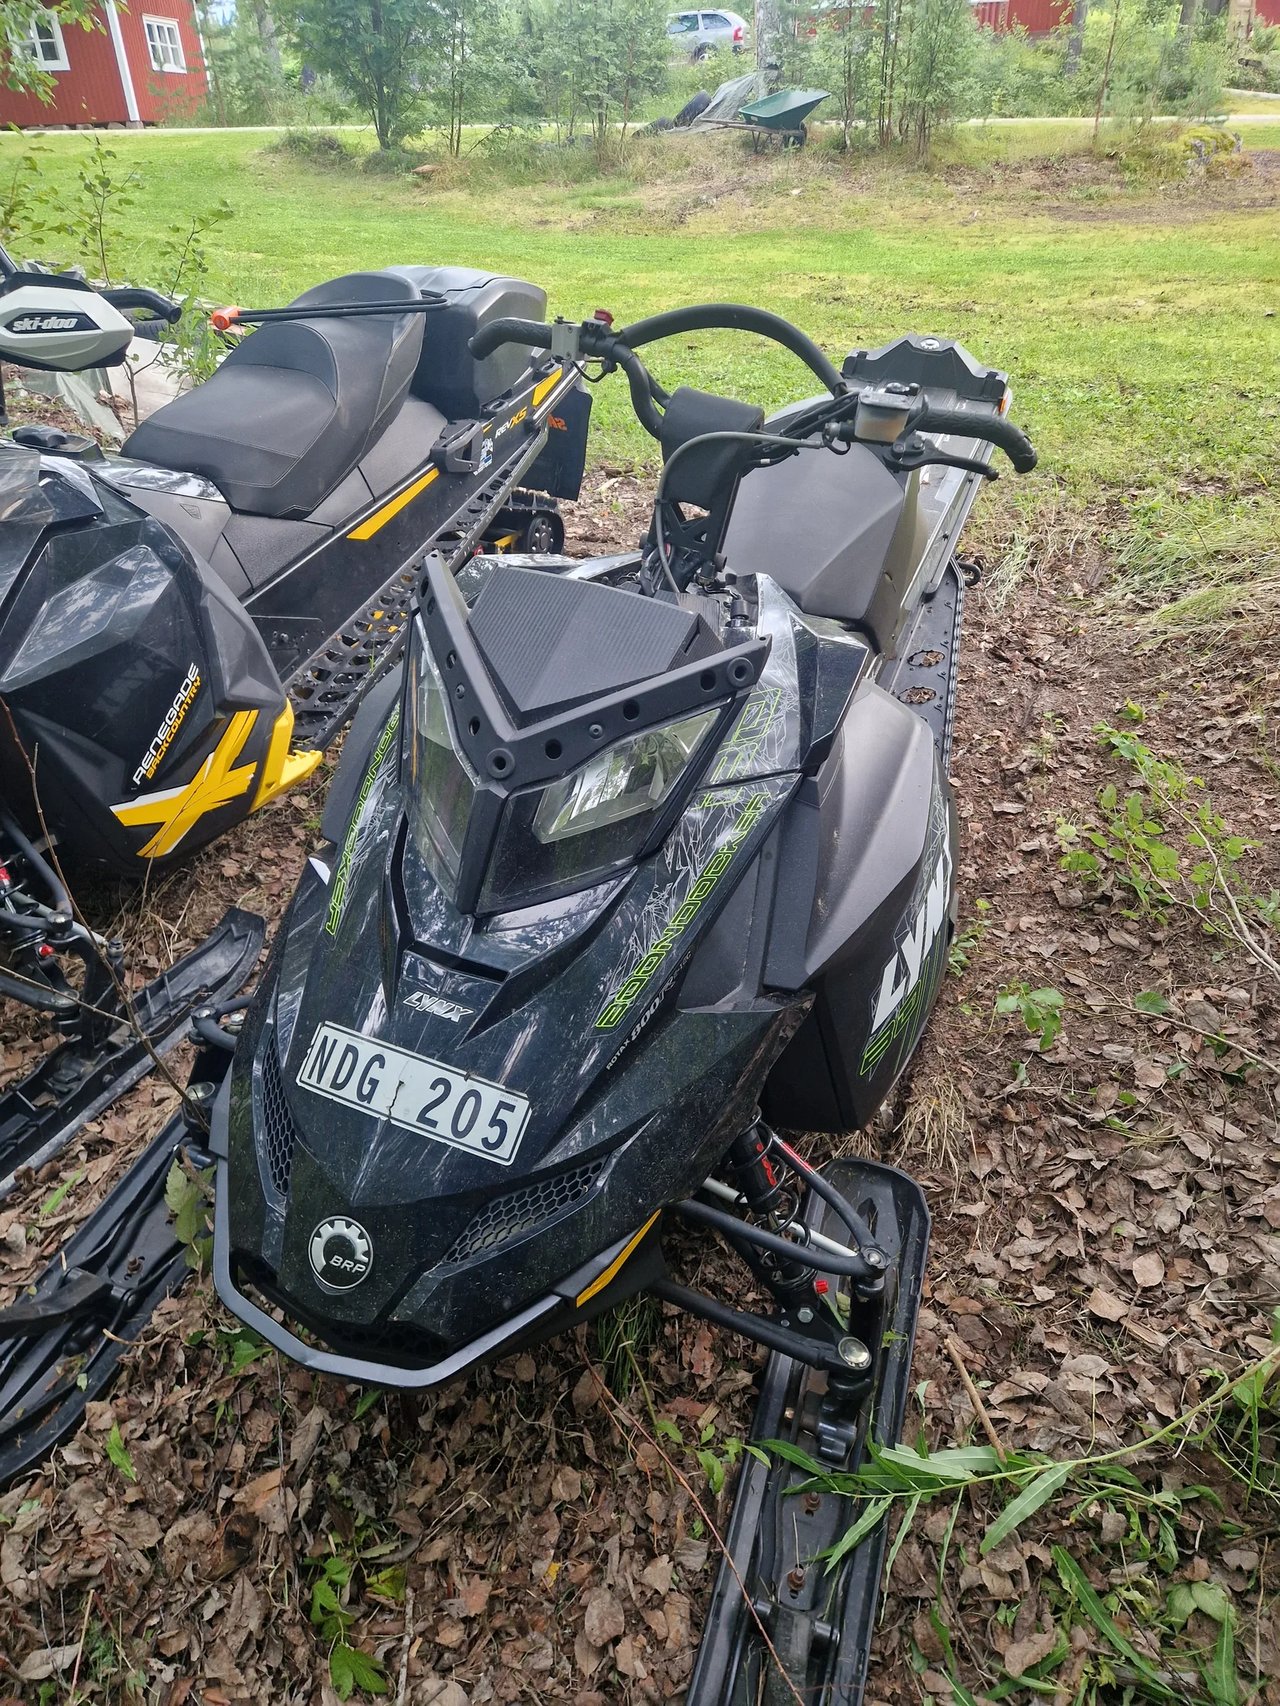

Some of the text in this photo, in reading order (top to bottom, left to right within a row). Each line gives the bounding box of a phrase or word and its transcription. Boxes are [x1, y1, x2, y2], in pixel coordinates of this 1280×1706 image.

[12, 316, 79, 332] ski-doo
[132, 662, 199, 785] RENEGADE
[145, 675, 201, 779] BACKCOUNTRY
[595, 791, 771, 1028] BOONDOCKER
[402, 990, 475, 1023] LYNX
[605, 1038, 632, 1071] ROTAX
[306, 1034, 518, 1152] NDG 205
[329, 1254, 367, 1273] BRP
